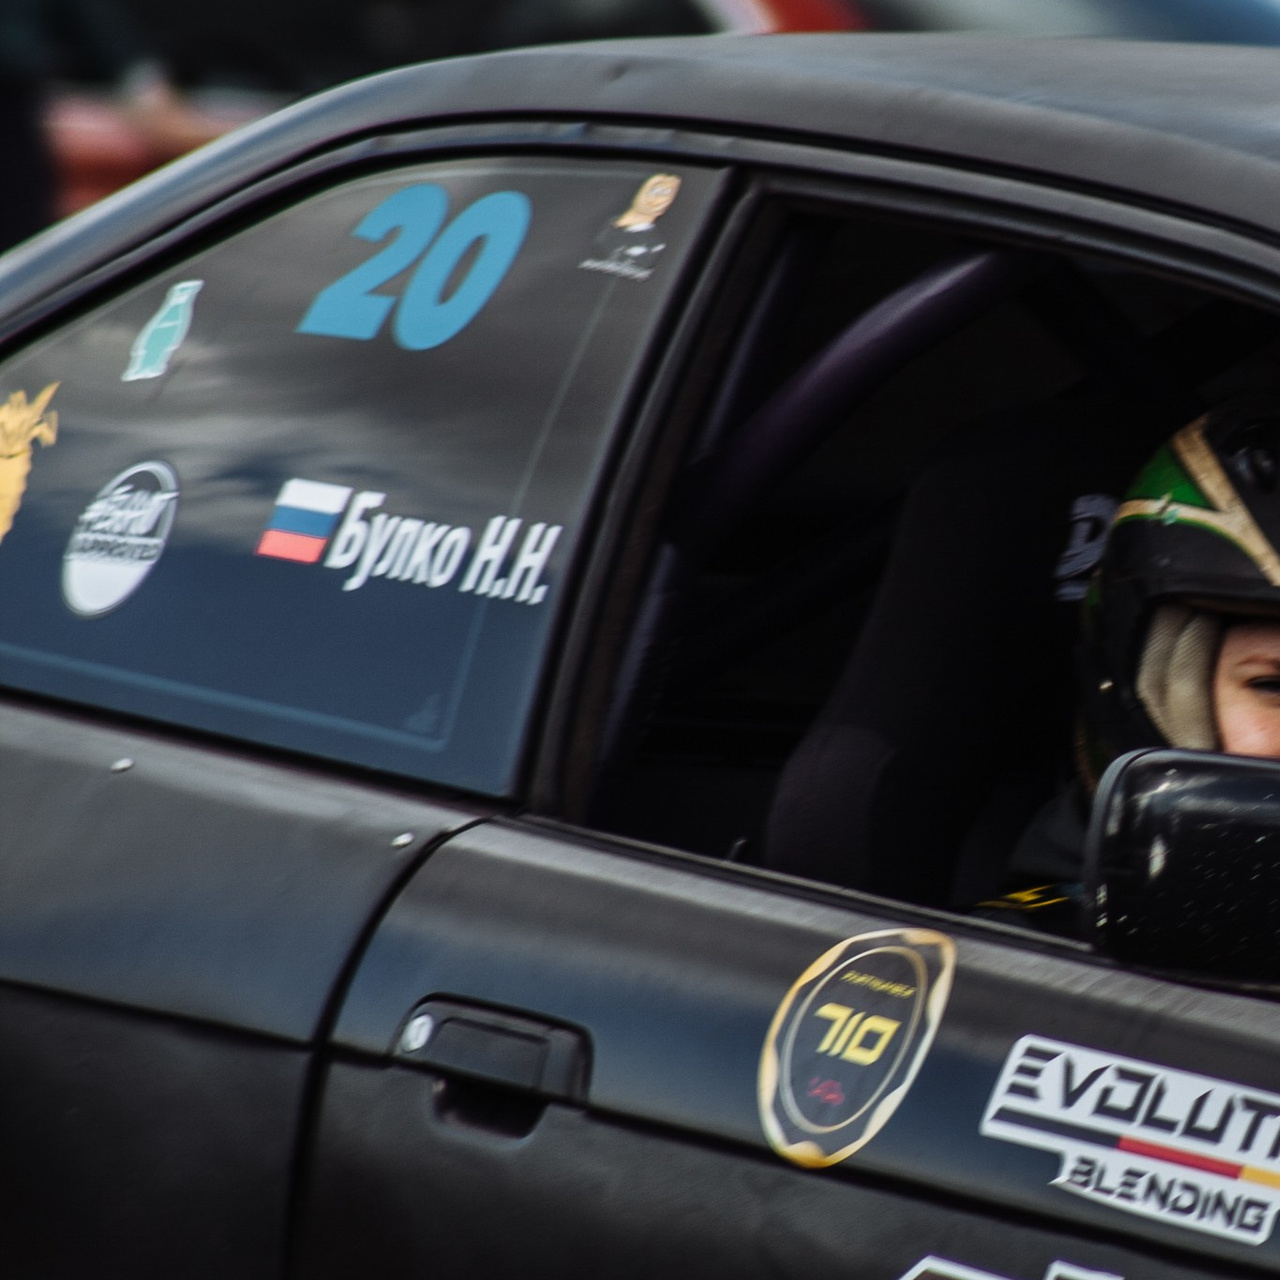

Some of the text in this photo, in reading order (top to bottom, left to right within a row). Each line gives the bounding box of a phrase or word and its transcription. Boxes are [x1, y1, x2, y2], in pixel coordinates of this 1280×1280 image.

[294, 182, 533, 351] 20
[323, 490, 472, 593] Булко
[813, 1001, 902, 1067] 710
[1064, 1155, 1273, 1235] BLENDING
